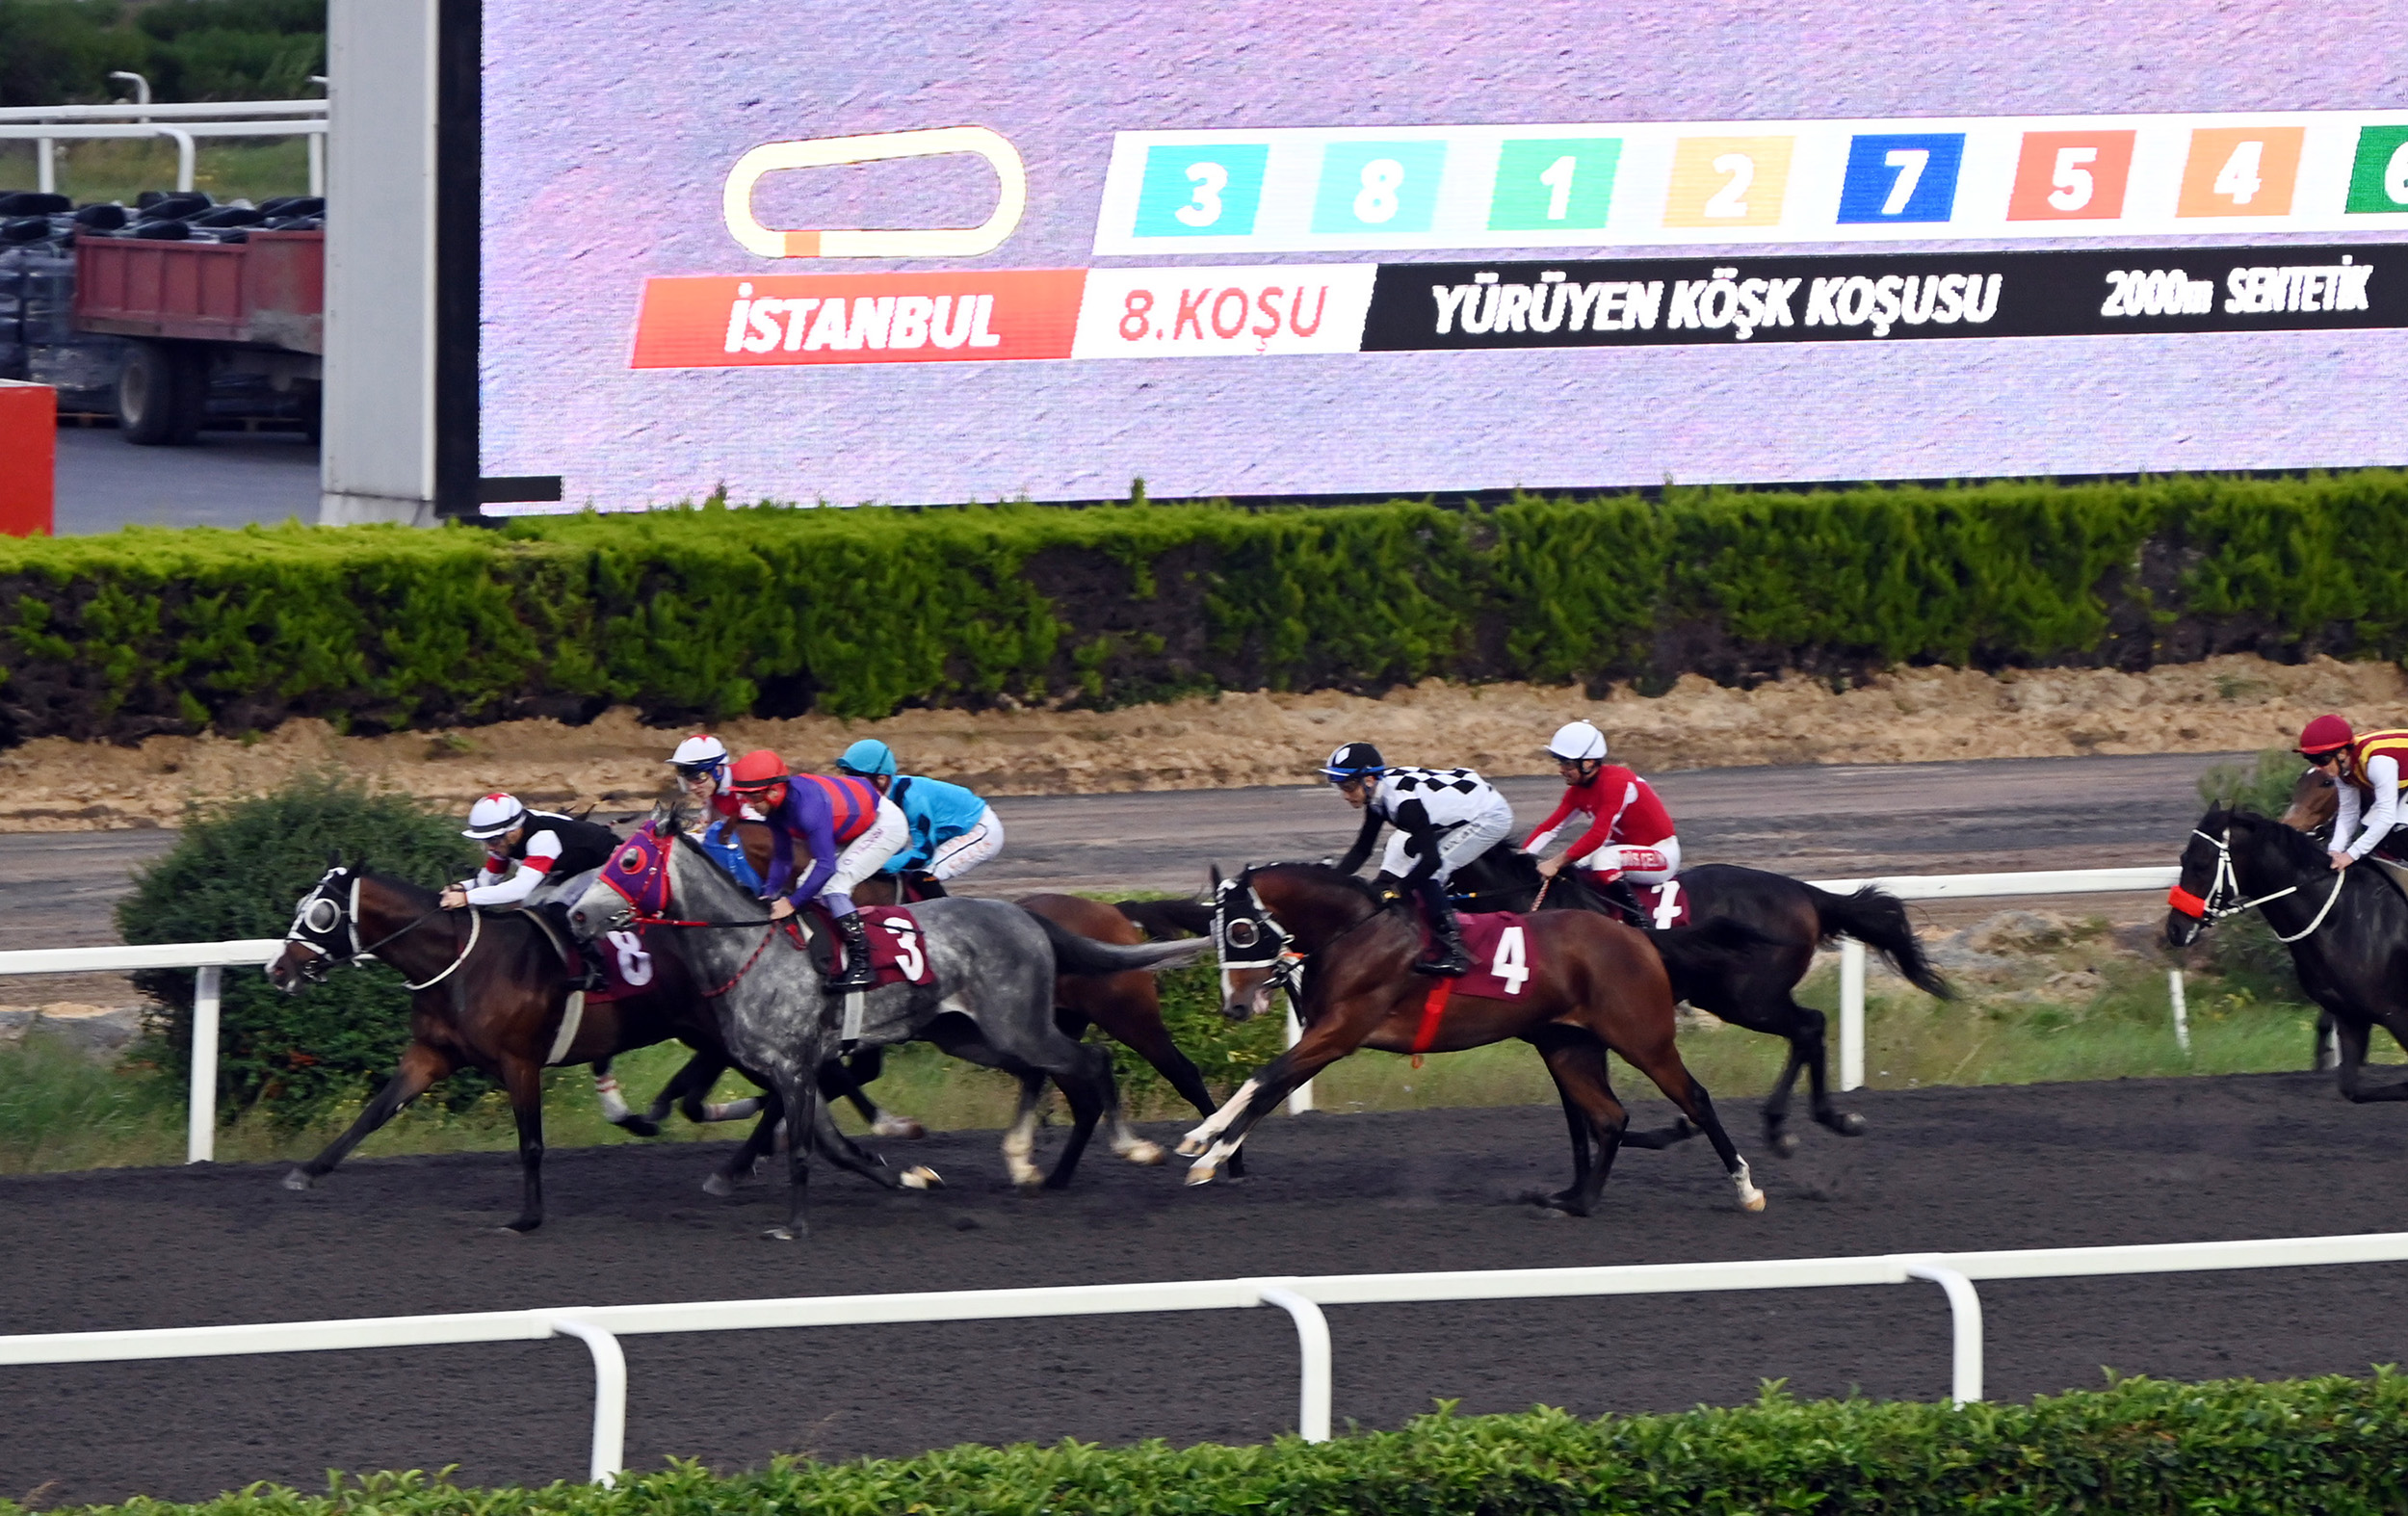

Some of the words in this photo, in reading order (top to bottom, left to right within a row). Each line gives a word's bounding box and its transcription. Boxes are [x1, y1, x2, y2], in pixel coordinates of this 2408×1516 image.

[1175, 162, 1228, 227] 3
[1352, 159, 1404, 223] 8
[1540, 155, 1576, 220] 1
[1703, 153, 1755, 219] 2
[1881, 149, 1930, 215] 7
[2047, 146, 2098, 211] 5
[2213, 141, 2264, 205] 4
[723, 282, 1001, 353] İSTANBUL
[1118, 285, 1329, 354] 8.KOŞU
[1431, 271, 1664, 334] YÜRÜYEN
[1666, 267, 1803, 340] KÖŞK
[1804, 273, 2002, 338] KOŞUSU
[2100, 269, 2214, 317] 2000m
[2224, 254, 2374, 314] SENTETİK
[606, 930, 653, 986] 8
[883, 916, 925, 981] 3
[1490, 926, 1530, 995] 4
